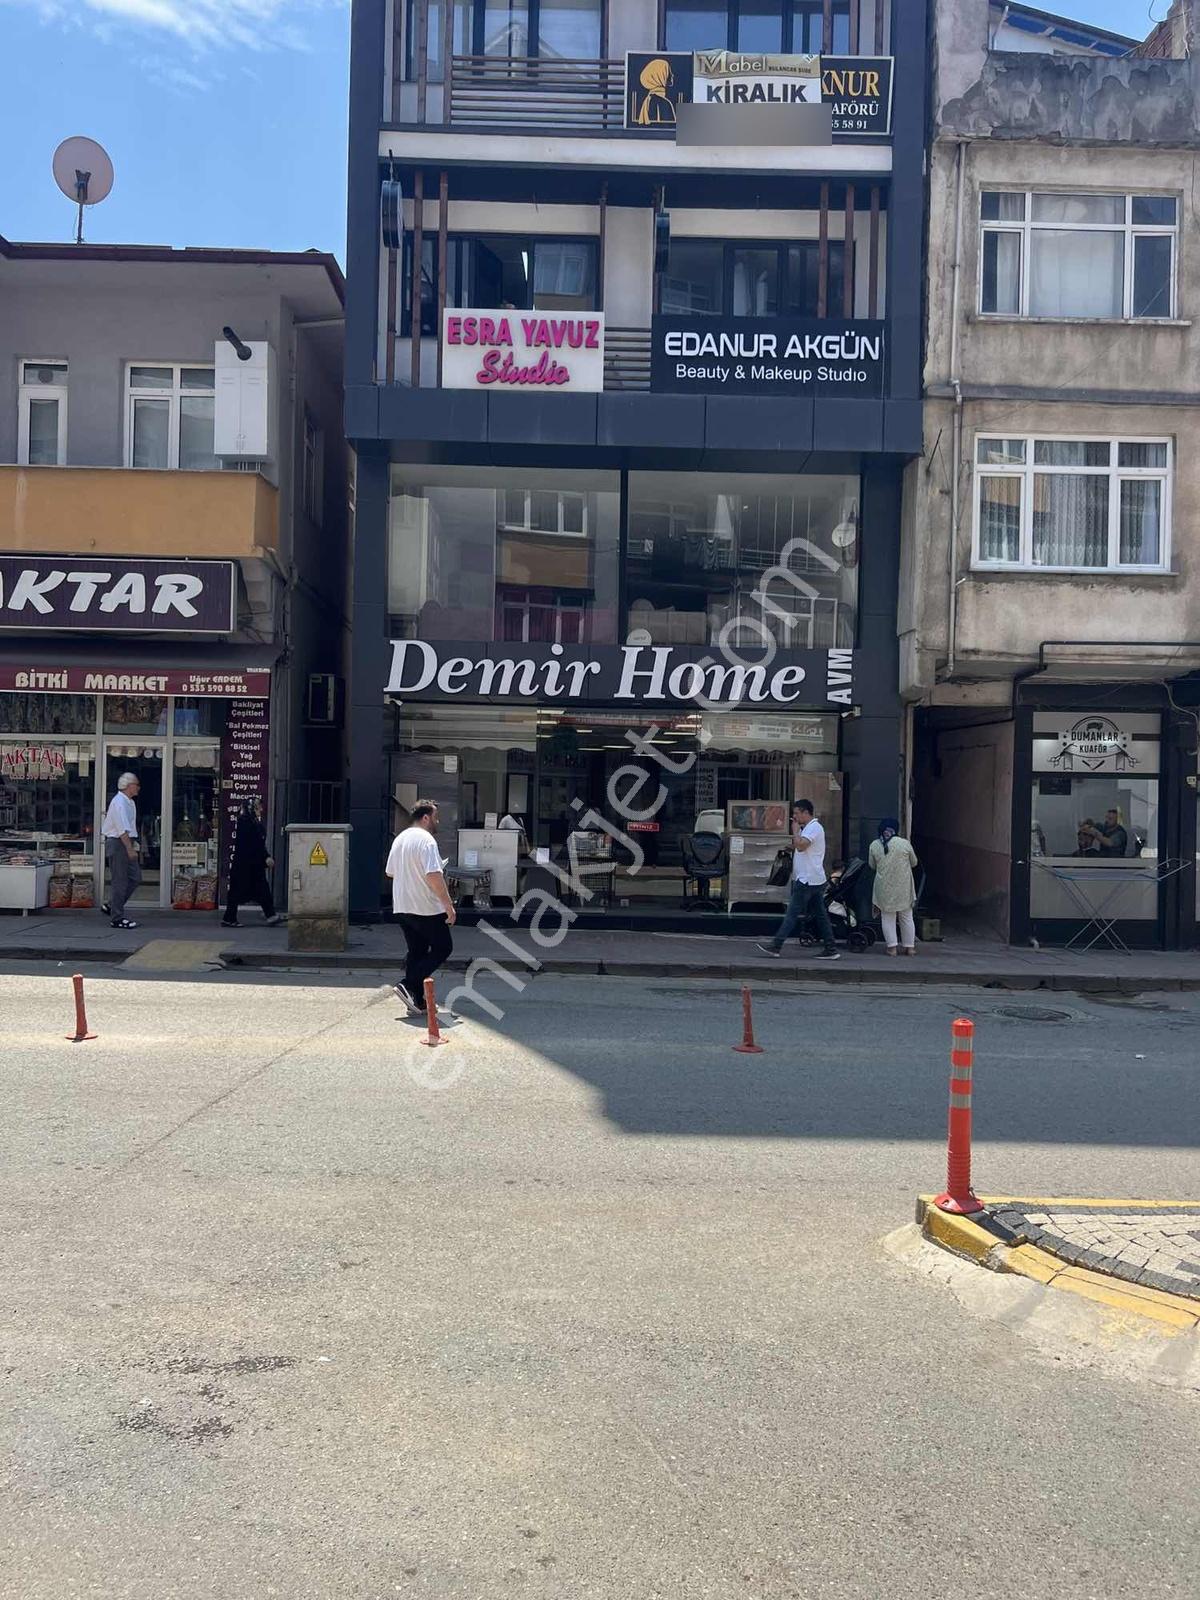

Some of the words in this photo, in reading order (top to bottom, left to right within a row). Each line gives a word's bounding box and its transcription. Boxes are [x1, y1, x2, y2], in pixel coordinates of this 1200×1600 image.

[696, 51, 767, 73] Mabel
[706, 80, 808, 103] KİRALIK
[842, 120, 854, 129] 58
[856, 120, 867, 129] 91
[447, 316, 513, 346] ESRA
[521, 319, 599, 349] YAVUZ
[664, 331, 777, 359] EDANUR
[783, 330, 880, 360] AKGÜN
[476, 349, 570, 386] Studio
[676, 363, 730, 383] Beauty
[734, 366, 746, 380] &
[751, 366, 812, 383] Makeup
[0, 570, 204, 618] KTAR
[383, 639, 601, 697] Demir
[613, 646, 806, 702] Home
[15, 668, 68, 689] BİTKİ
[85, 673, 169, 691] MARKET
[189, 675, 210, 685] Uğur
[826, 648, 853, 705] AVM
[182, 684, 188, 692] 0
[190, 684, 205, 692] 535
[237, 685, 248, 693] 52
[232, 701, 264, 710] Bakliyat
[231, 709, 264, 718] Çeşitleri
[241, 722, 269, 730] Pekmez
[232, 731, 262, 739] Çeşitleri
[1071, 731, 1119, 742] DUMANLAR
[1079, 744, 1108, 753] KUAFÖR
[2, 745, 65, 771] AKTAR
[239, 752, 253, 761] Yağ
[231, 761, 261, 769] Çeşitleri
[234, 782, 248, 791] Çay
